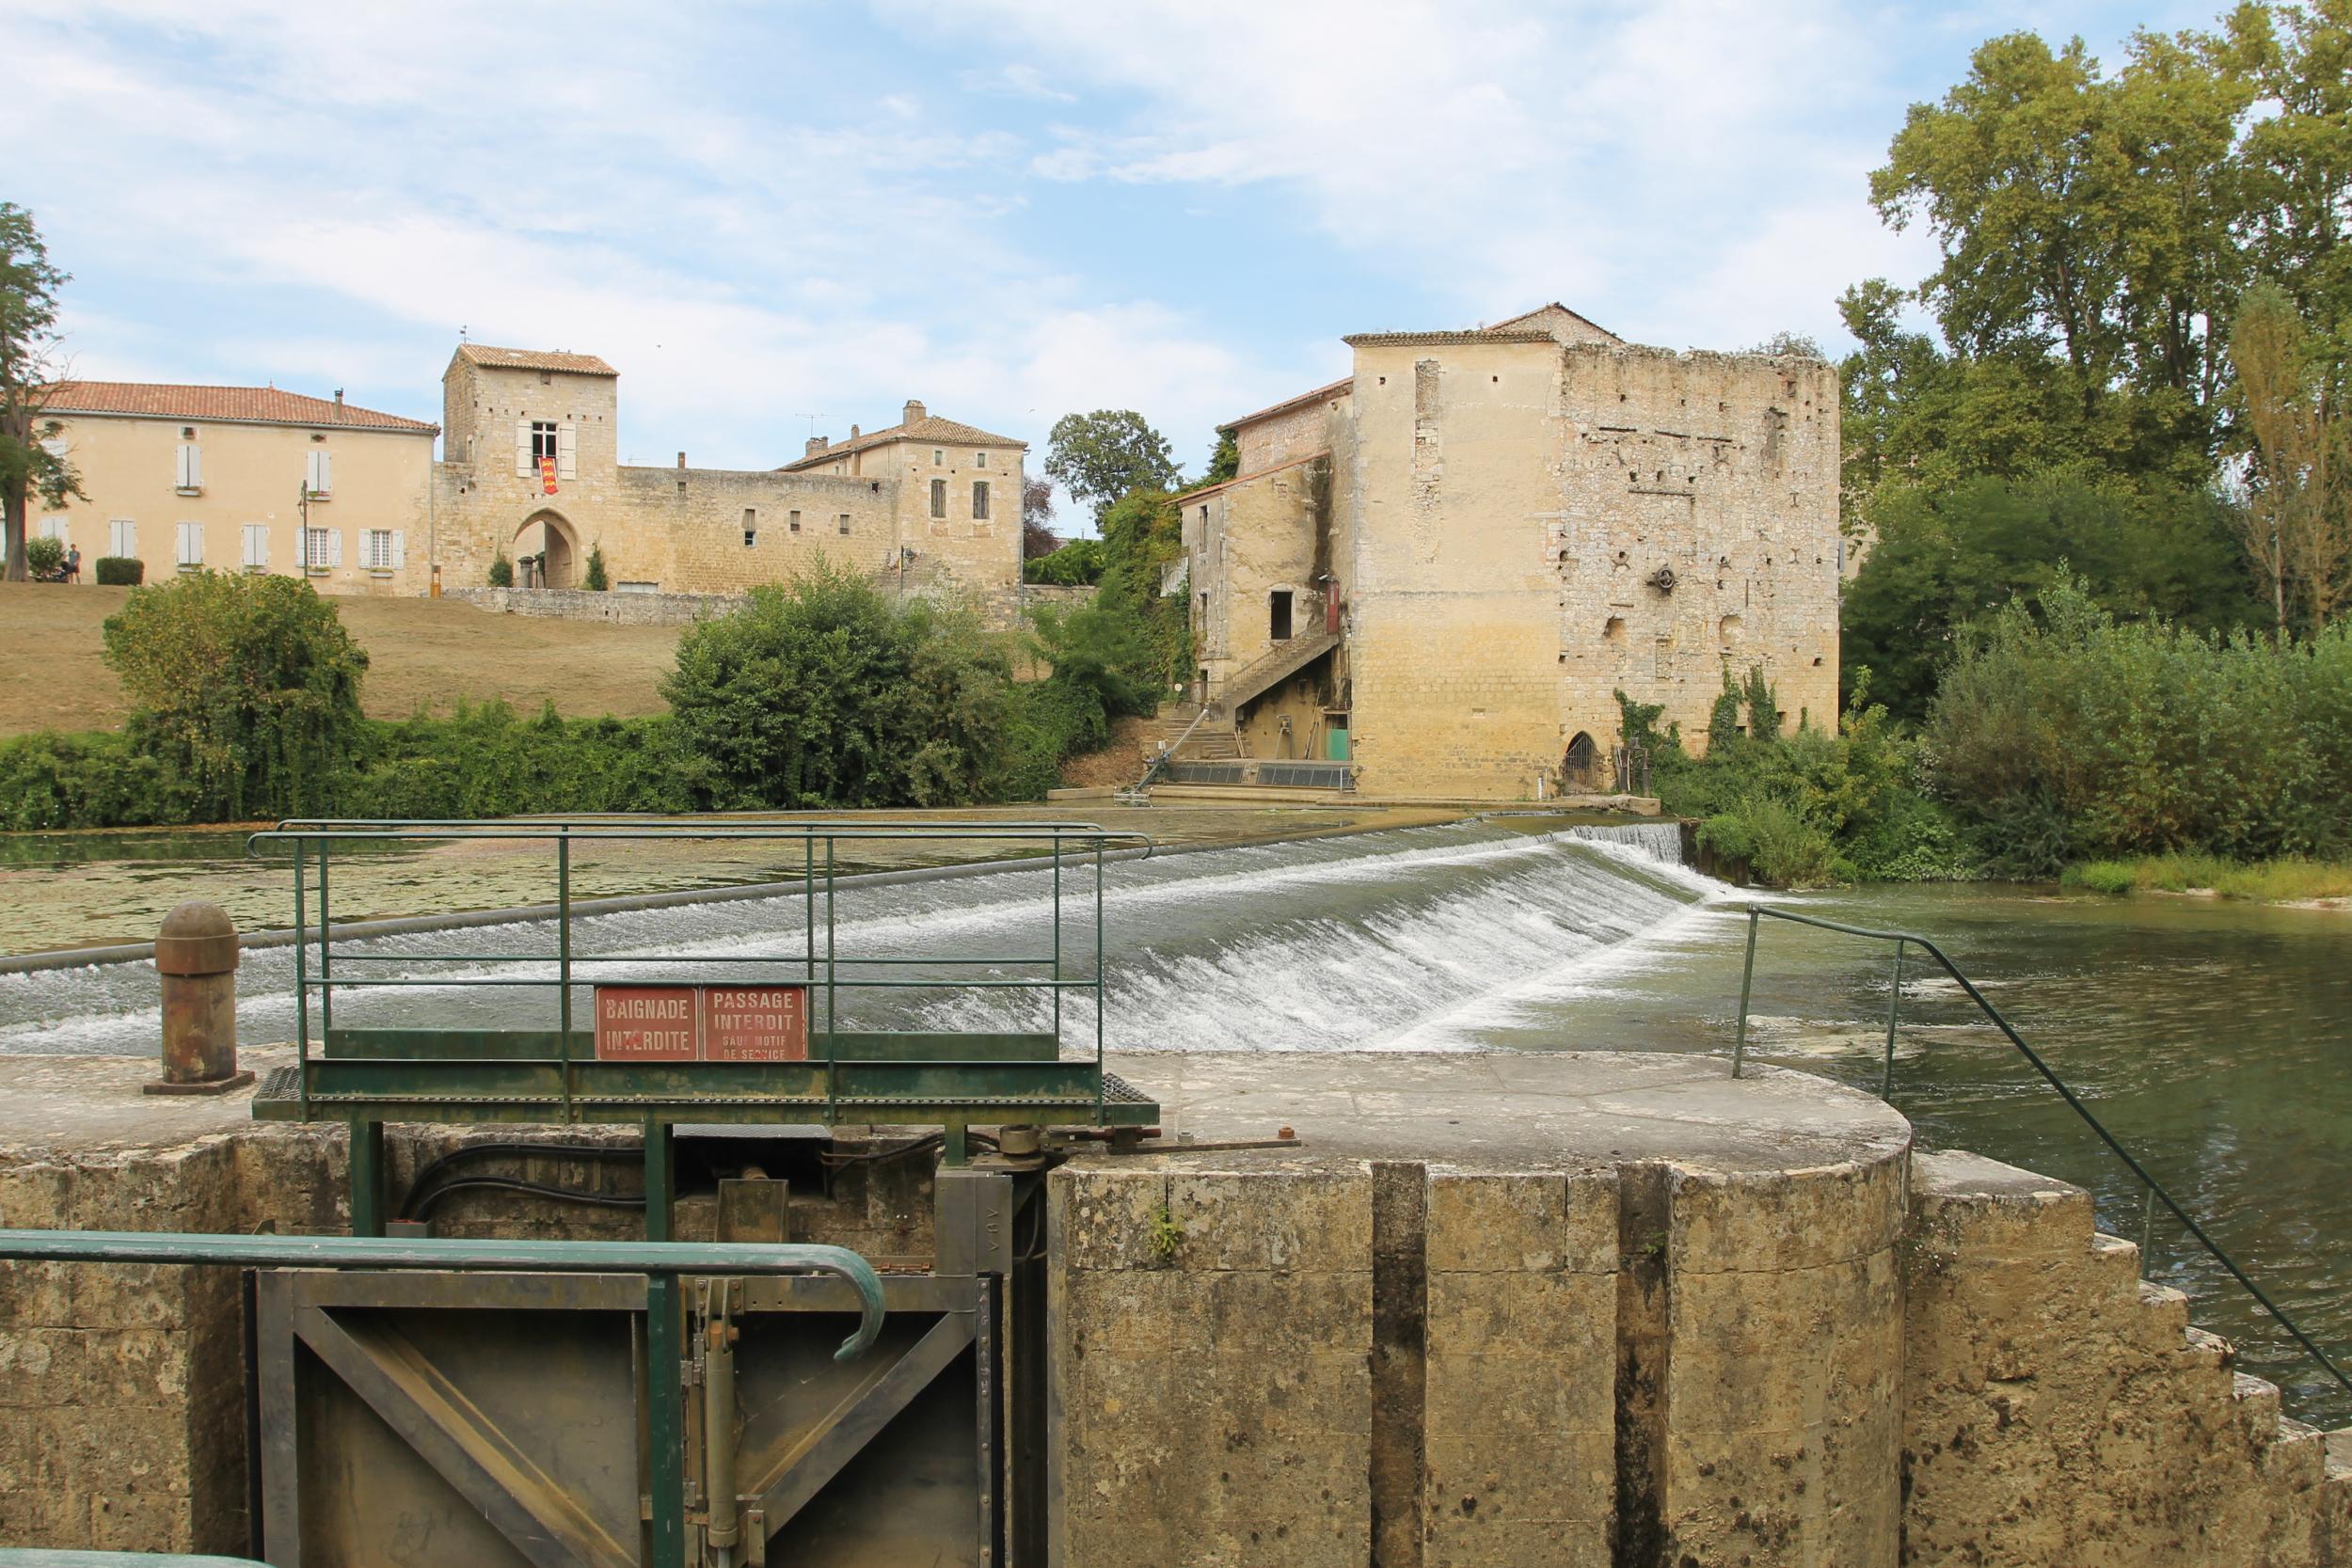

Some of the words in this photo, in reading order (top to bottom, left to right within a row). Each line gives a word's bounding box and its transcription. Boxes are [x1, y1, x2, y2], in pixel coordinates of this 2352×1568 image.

[714, 992, 793, 1008] PASSAGE
[606, 999, 688, 1020] BAIGNADE
[715, 1014, 793, 1030] INTERDIT
[723, 1049, 737, 1060] DE
